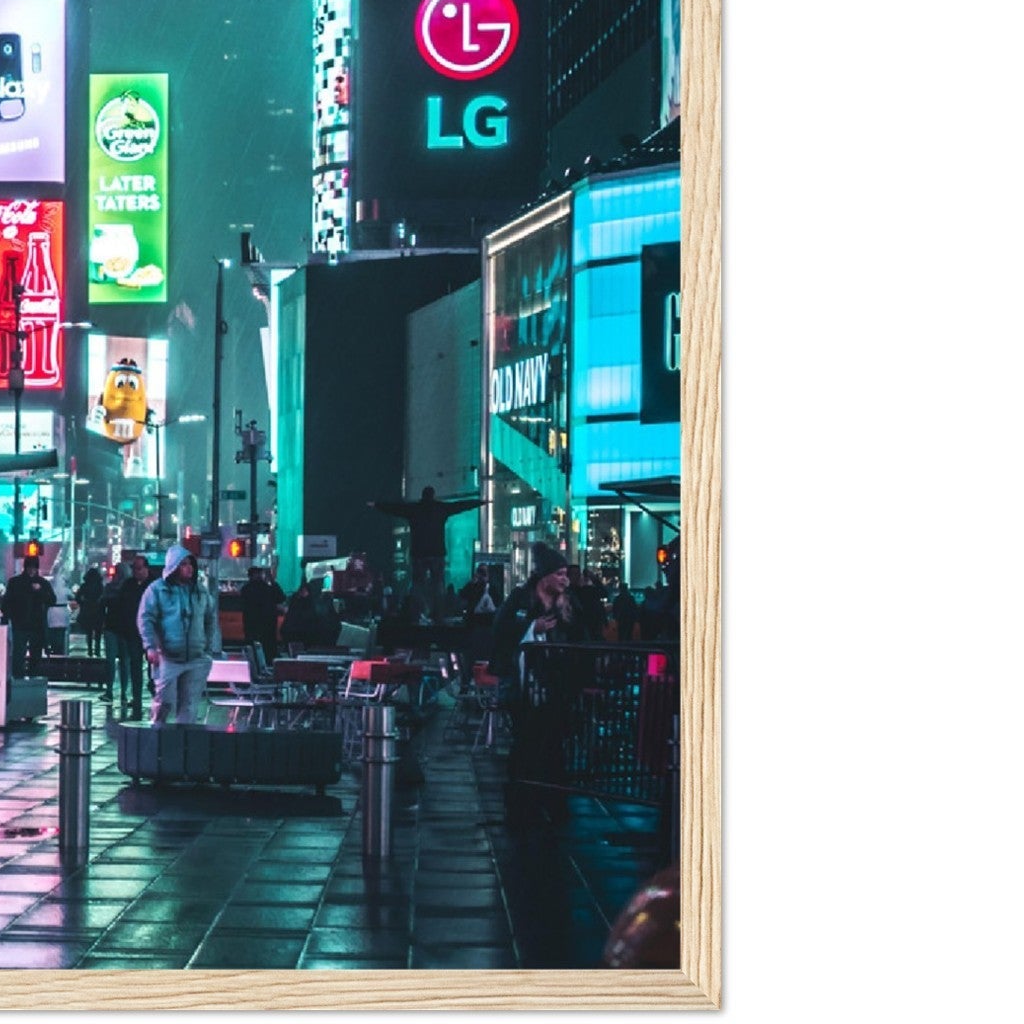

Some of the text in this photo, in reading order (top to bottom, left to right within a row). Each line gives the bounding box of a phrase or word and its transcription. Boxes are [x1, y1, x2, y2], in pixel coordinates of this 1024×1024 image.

[426, 95, 509, 150] LG
[98, 175, 156, 192] LATER
[94, 194, 161, 212] TATERS
[490, 352, 549, 414] OLD NAVY
